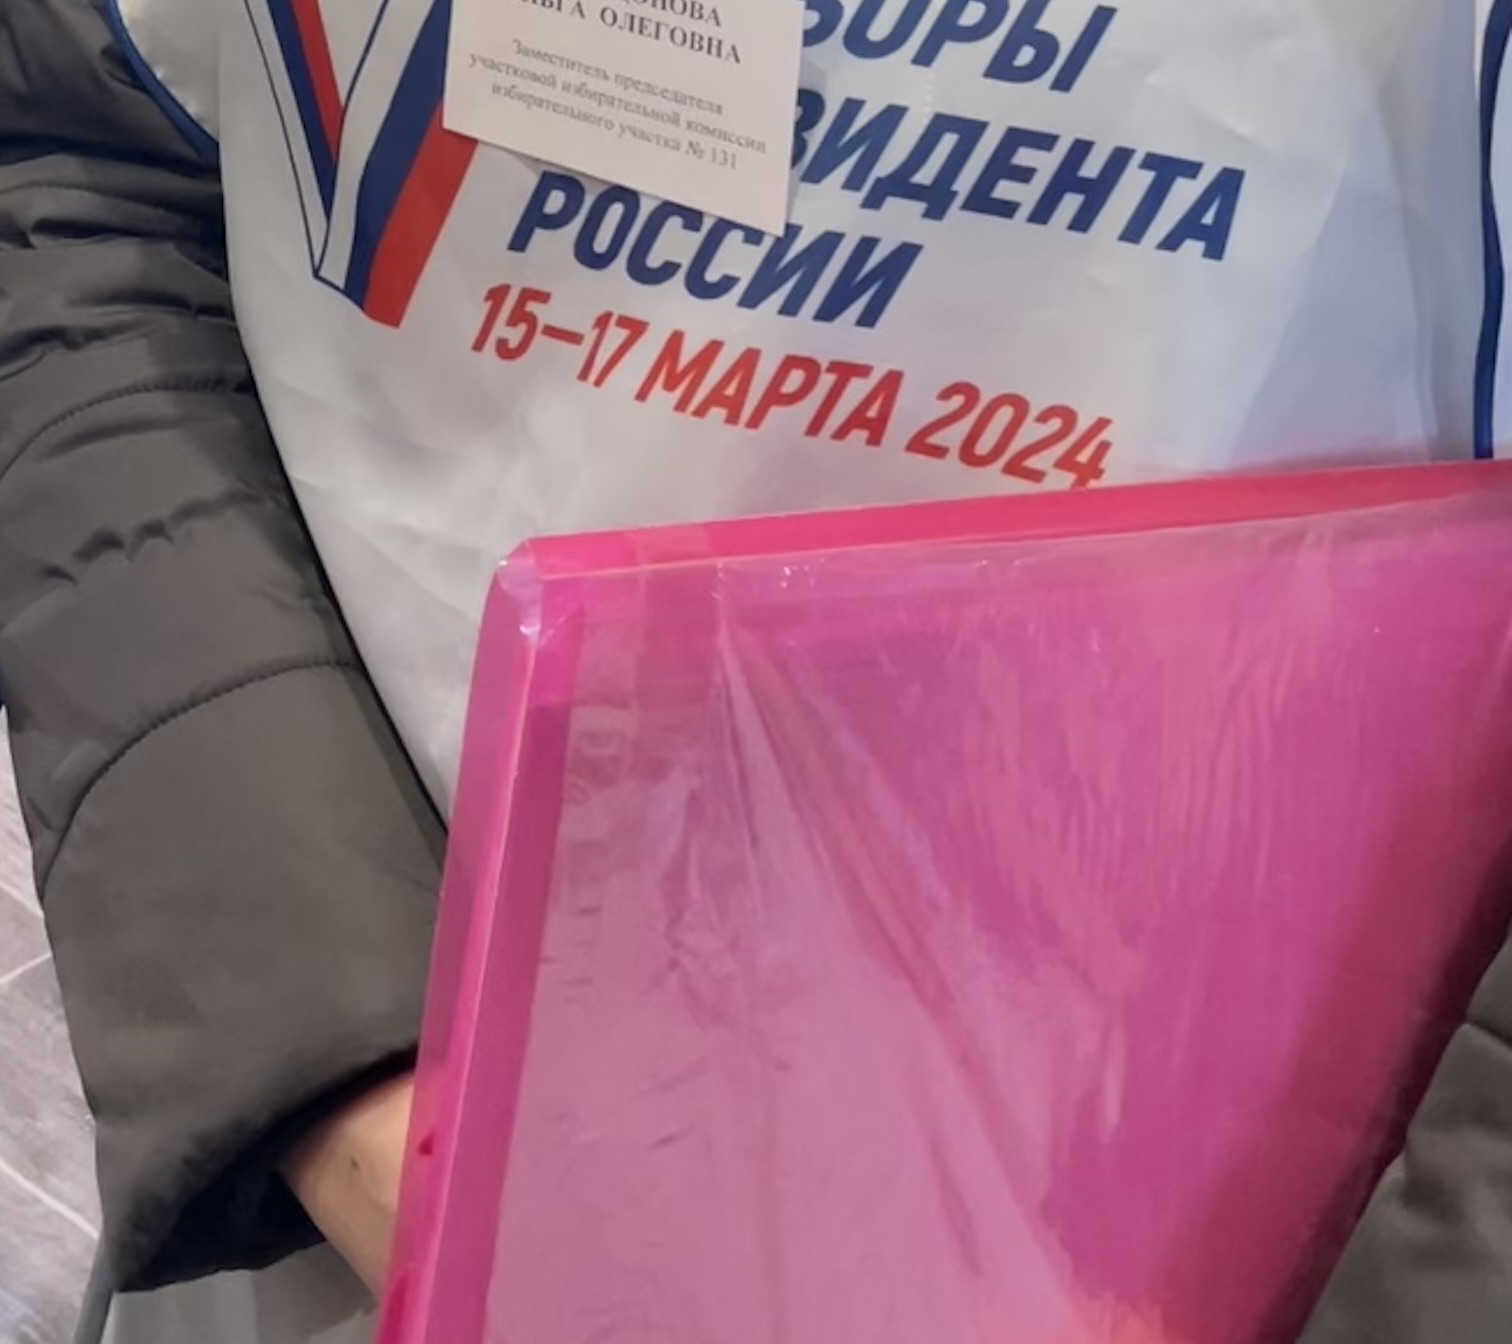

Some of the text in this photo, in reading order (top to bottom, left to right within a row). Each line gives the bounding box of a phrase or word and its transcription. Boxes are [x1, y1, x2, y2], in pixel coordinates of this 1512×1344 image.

[512, 38, 723, 116] Заместитель председателя
[599, 6, 742, 65] ОЛЕГОВНА
[469, 51, 767, 154] участковой избирательной комиссии
[491, 81, 614, 132] избирательного
[618, 123, 682, 154] участка
[710, 149, 738, 170] 131
[506, 170, 925, 330] РОССИИ
[634, 329, 906, 448] МАРТА
[903, 381, 1115, 490] 2024
